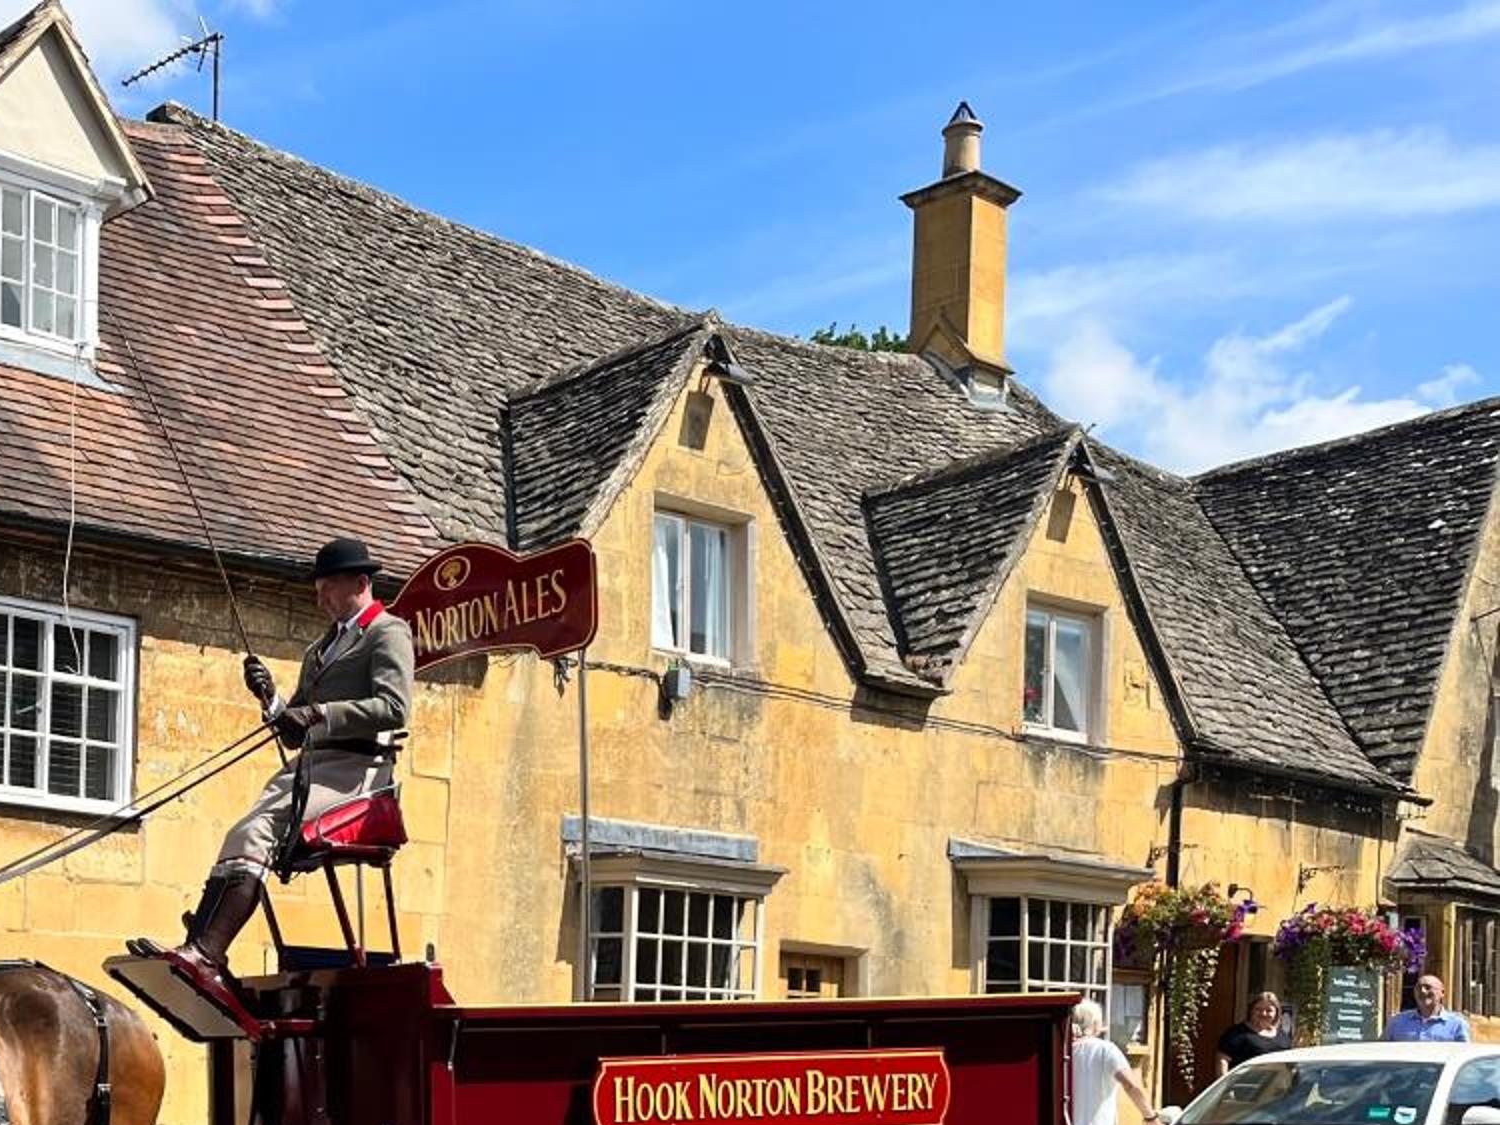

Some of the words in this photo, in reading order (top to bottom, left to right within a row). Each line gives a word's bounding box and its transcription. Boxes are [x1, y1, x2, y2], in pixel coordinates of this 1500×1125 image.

[415, 591, 500, 657] NORTON
[503, 568, 568, 630] ALES
[613, 1075, 694, 1123] HOOK
[698, 1072, 801, 1119] NORTON
[805, 1069, 939, 1115] BREWERY
